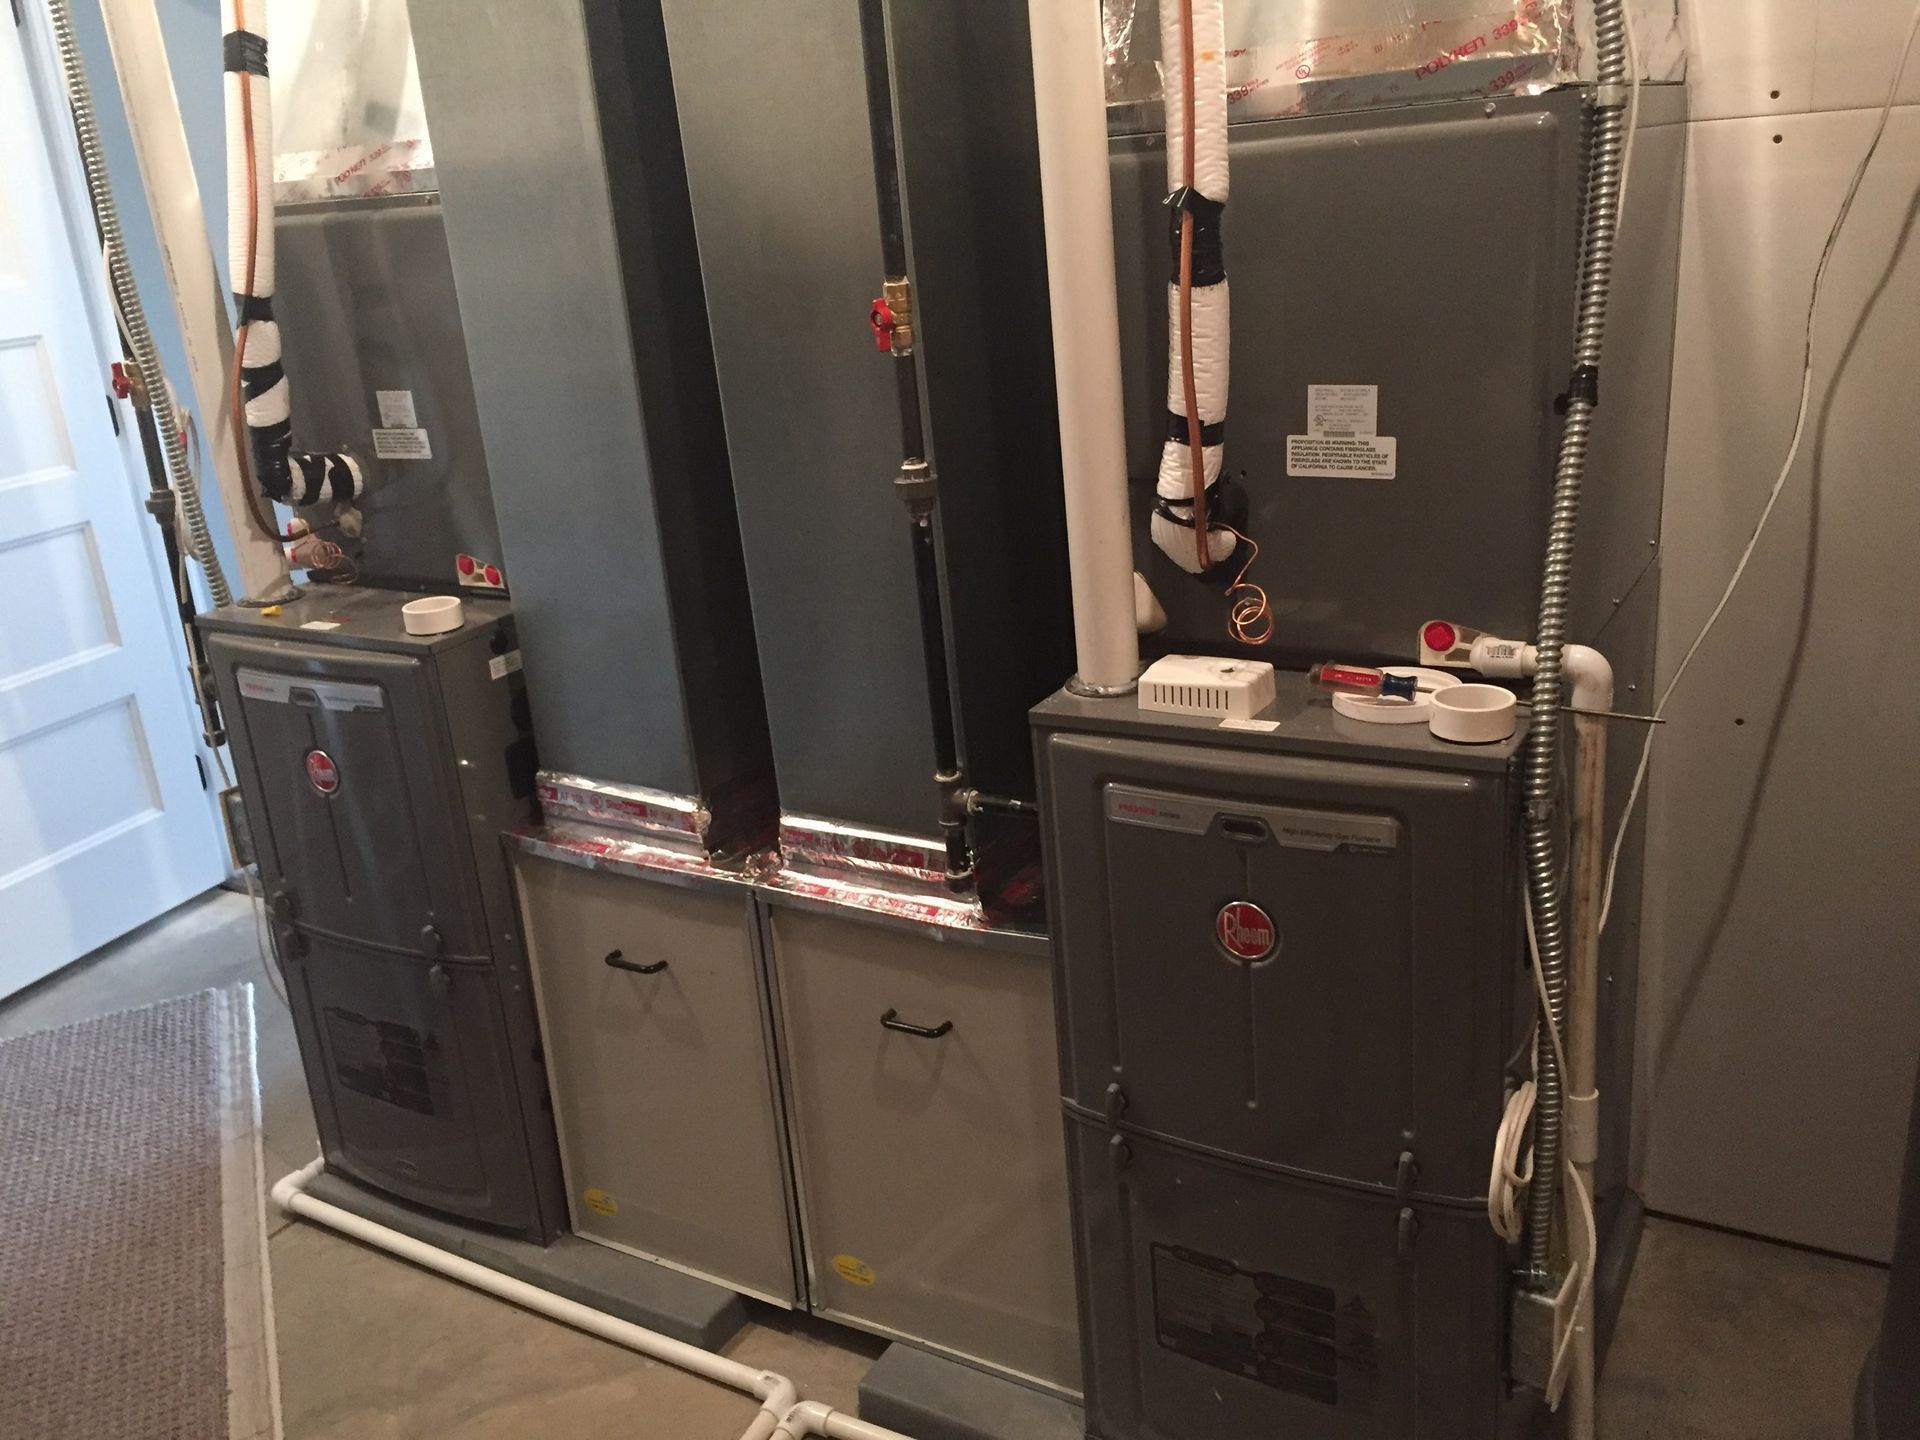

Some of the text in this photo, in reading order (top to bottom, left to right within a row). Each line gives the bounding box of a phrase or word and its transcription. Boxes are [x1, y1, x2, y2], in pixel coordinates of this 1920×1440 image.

[1414, 35, 1486, 80] POLYKEN
[1492, 19, 1518, 41] 339
[1224, 907, 1270, 950] Rheem
